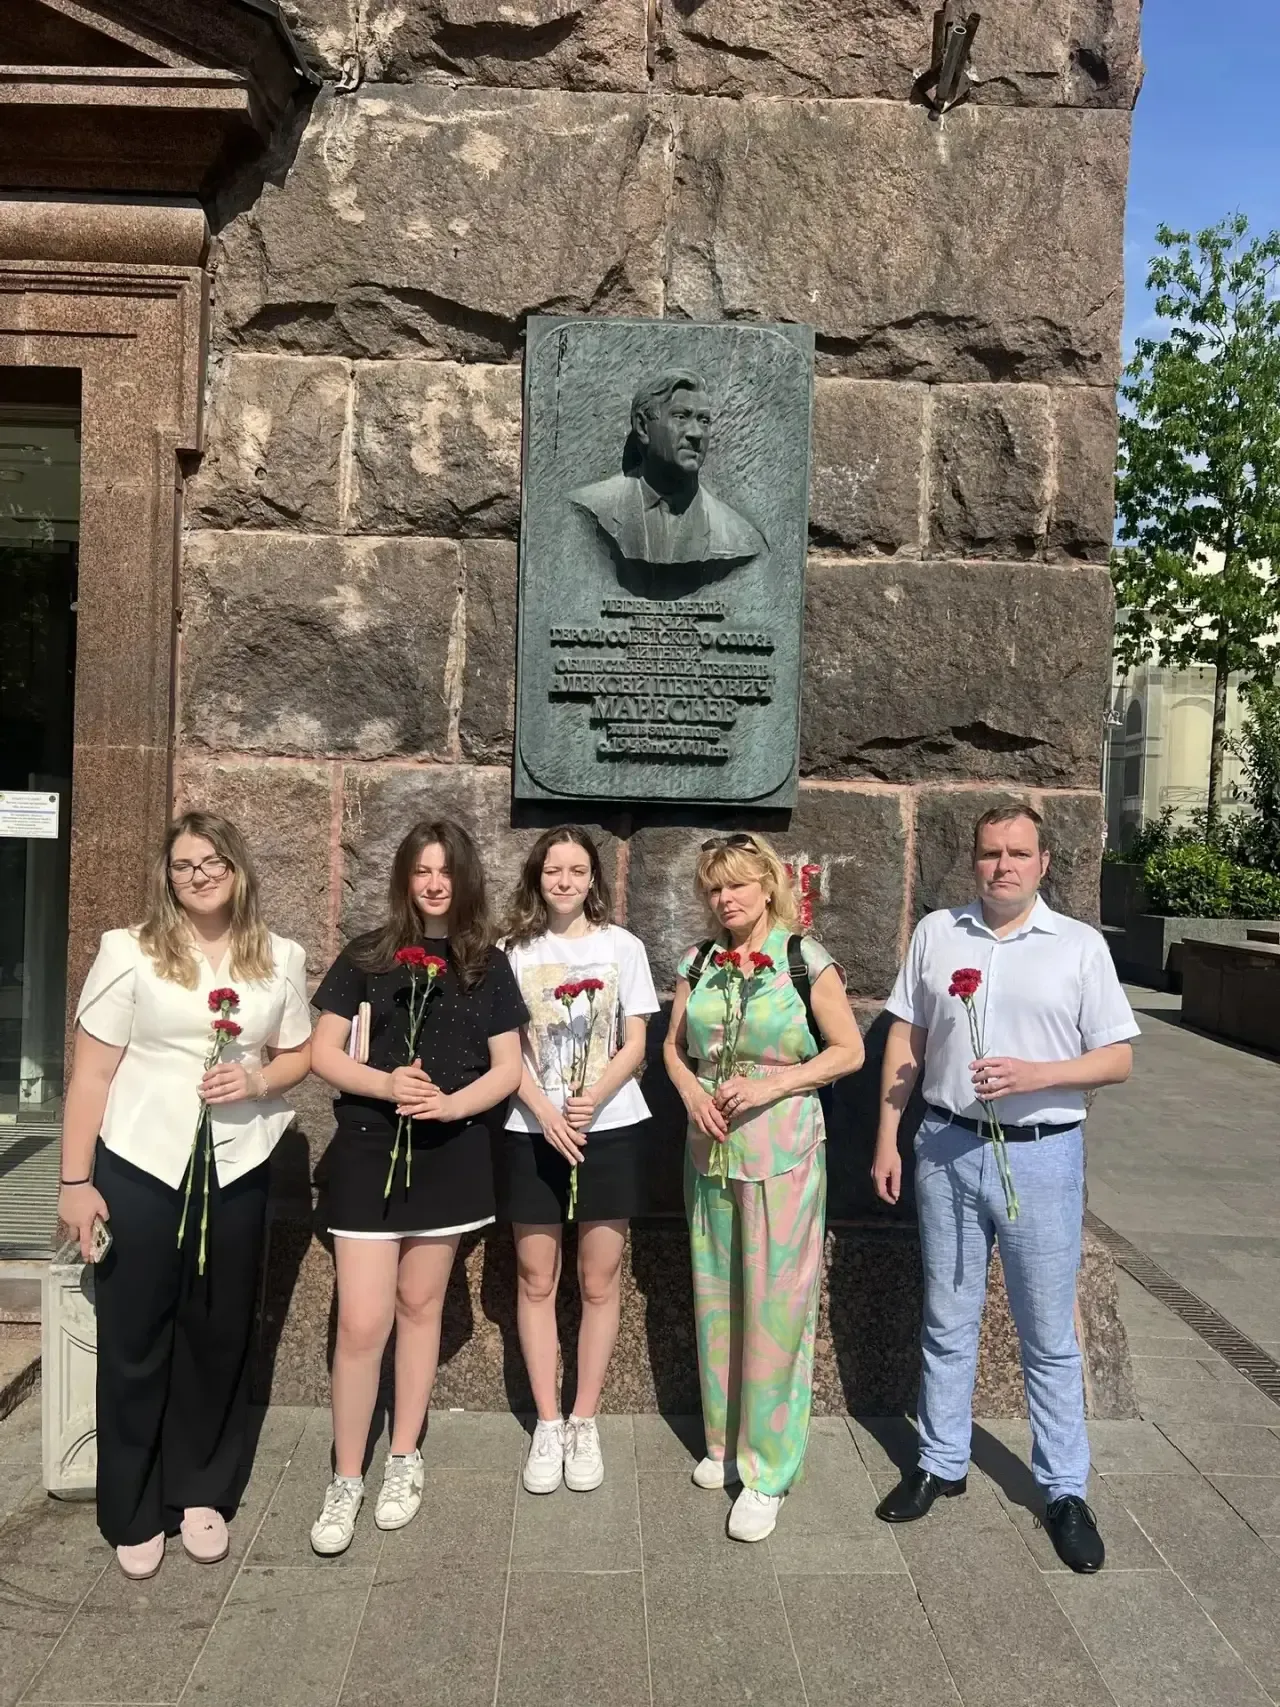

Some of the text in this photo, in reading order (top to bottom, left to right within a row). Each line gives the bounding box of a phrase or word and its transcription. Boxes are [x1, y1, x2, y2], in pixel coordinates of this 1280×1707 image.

[603, 600, 725, 615] ЛЕГЕНДАРНЫЙ
[631, 615, 699, 630] ЛЕТЧИК
[550, 628, 773, 648] ГЕРОЙ СОВЕТСКОГО СОЮЗА
[555, 657, 770, 677] ОБЩЕСТВЕННЫЙ ДЕЯТЕЛЬ
[551, 674, 774, 698] АЛЕКСЕЙ ПЕТРОВИЧ
[591, 696, 738, 722] МАРЕСЬЕВ
[668, 740, 709, 755] 2001
